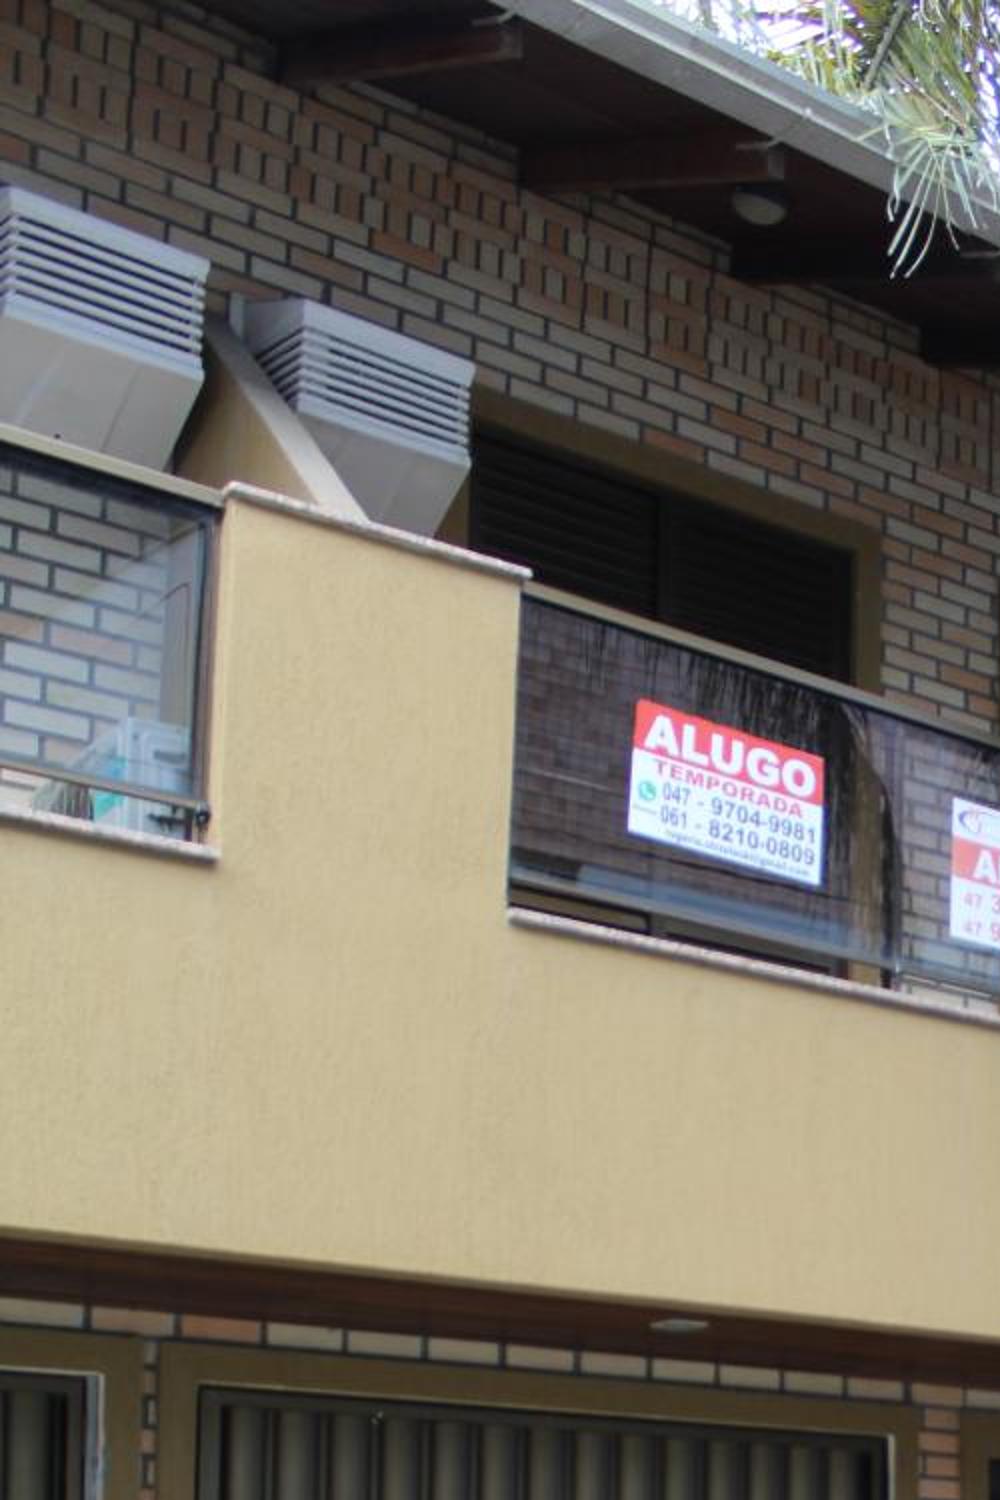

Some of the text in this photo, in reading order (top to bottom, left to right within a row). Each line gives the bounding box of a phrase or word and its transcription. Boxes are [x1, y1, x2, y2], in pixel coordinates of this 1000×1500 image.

[644, 715, 817, 798] ALUGO
[655, 760, 804, 819] TEMPORADA
[660, 805, 688, 829] 061
[662, 782, 692, 807] 047
[710, 797, 817, 844] 9704-9981
